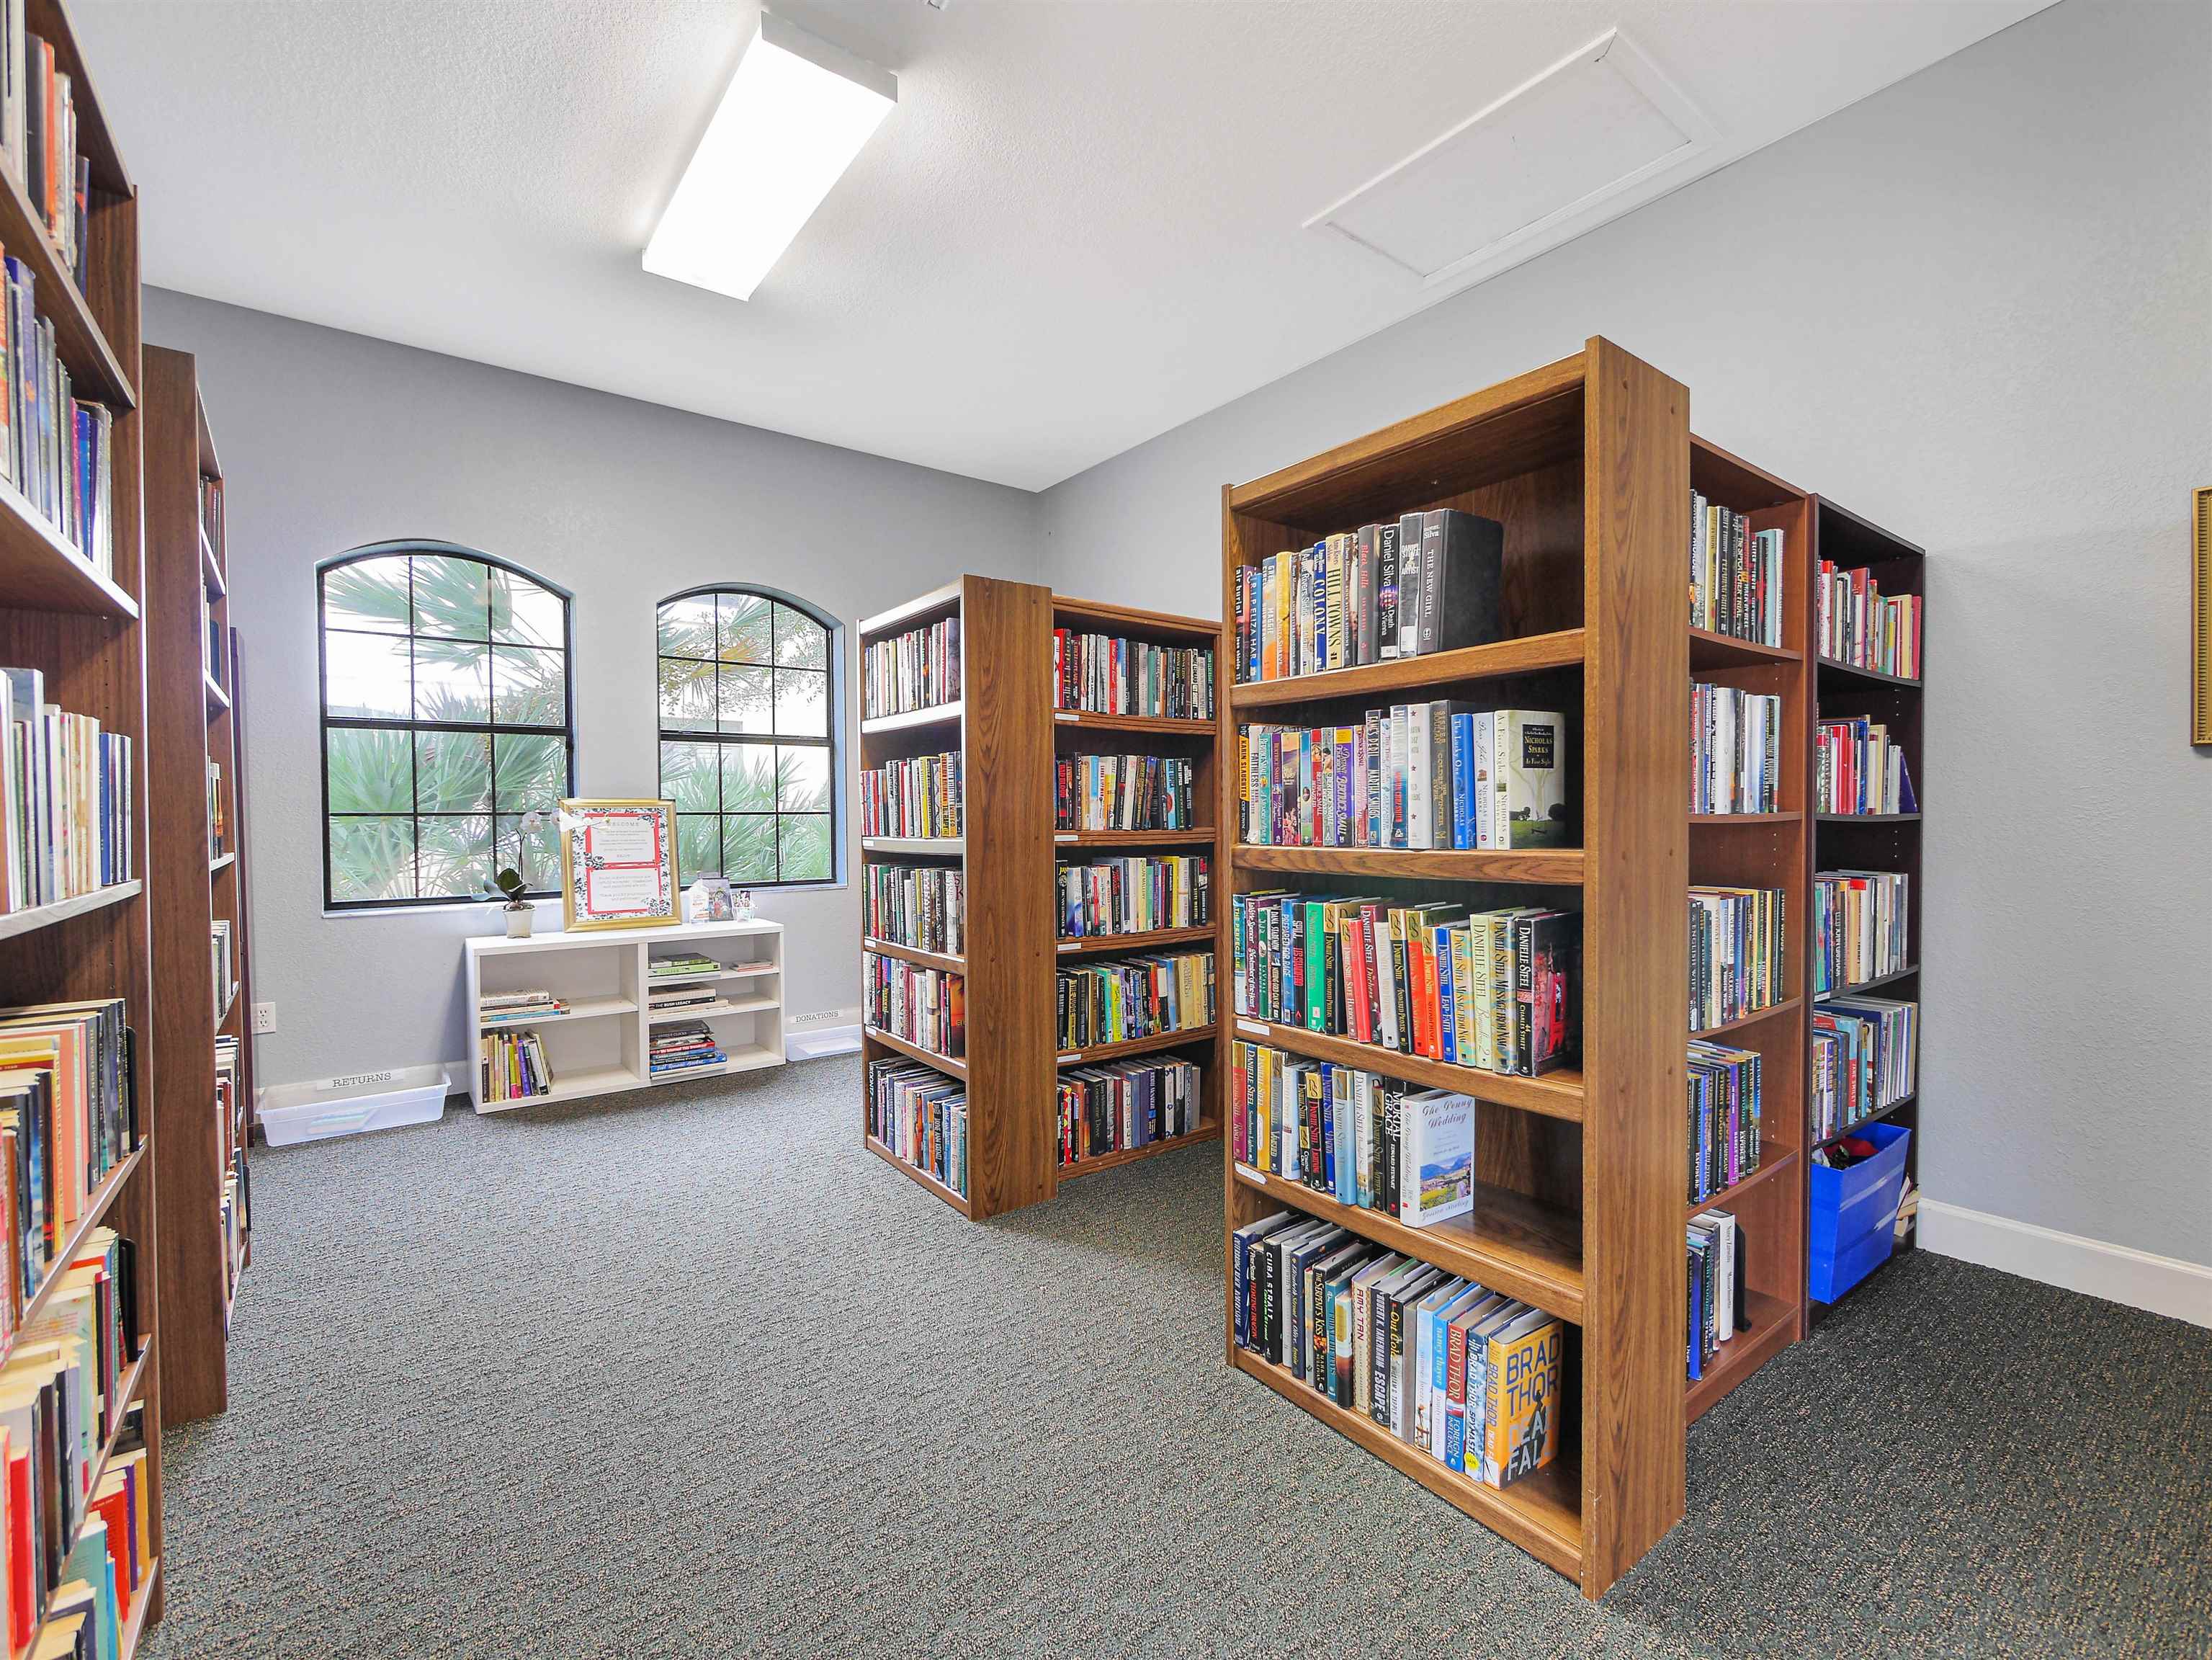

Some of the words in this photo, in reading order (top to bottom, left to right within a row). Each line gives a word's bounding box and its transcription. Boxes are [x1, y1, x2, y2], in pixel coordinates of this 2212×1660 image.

[1384, 530, 1394, 561] Daniel
[1328, 568, 1341, 599] HILL
[1384, 564, 1394, 587] Silva
[1314, 579, 1325, 635] COLONY
[1328, 600, 1341, 646] TOWNS
[1368, 738, 1379, 757] PERIL
[1524, 736, 1553, 744] NICHOLAS
[1528, 745, 1549, 754] SPARKS
[1497, 751, 1505, 773] Sight
[1337, 776, 1347, 811] BERTRICE
[1369, 769, 1379, 794] MARTHA
[1337, 811, 1347, 835] SMALL
[1271, 911, 1280, 924] DANA
[1292, 920, 1304, 939] SPILL
[1362, 911, 1371, 942] DANIELLE
[1247, 921, 1255, 943] Spencer
[1495, 922, 1507, 953] DANIELLE
[1474, 925, 1486, 968] DANIELLE
[1519, 927, 1531, 964] DANIELLE
[1248, 948, 1256, 977] November
[1456, 963, 1465, 981] STEEL
[1496, 954, 1508, 977] STEEL
[1440, 968, 1449, 986] STEEL
[1475, 972, 1487, 999] STEEL
[1520, 965, 1531, 987] STEEL
[1442, 995, 1451, 1010] LEAP
[1496, 980, 1508, 1012] MESSAGE
[795, 1011, 839, 1022] DONATIONS
[1443, 1014, 1451, 1032] FAITH
[1496, 1012, 1508, 1030] FROM
[1459, 1030, 1469, 1043] NAM
[1496, 1032, 1510, 1047] NAM
[333, 1072, 391, 1087] RETURNS
[1355, 1076, 1364, 1111] DANIELLE
[1392, 1091, 1402, 1141] MORTAL
[1423, 1105, 1439, 1117] The
[1428, 1112, 1467, 1129] Wedding
[1315, 1282, 1324, 1316] SERPENT'S
[1376, 1295, 1384, 1319] ROBERT
[1315, 1318, 1324, 1336] KISS
[1391, 1311, 1400, 1331] Out
[1434, 1327, 1443, 1353] nancy
[1450, 1329, 1461, 1362] BRAD
[1435, 1356, 1445, 1385] thayer
[1506, 1333, 1560, 1386] BRAD
[1448, 1366, 1461, 1399] THOR
[1488, 1363, 1498, 1394] BRAD
[1374, 1371, 1386, 1411] ESCAPE
[1506, 1365, 1559, 1417] THOR
[1487, 1398, 1498, 1427] THOR
